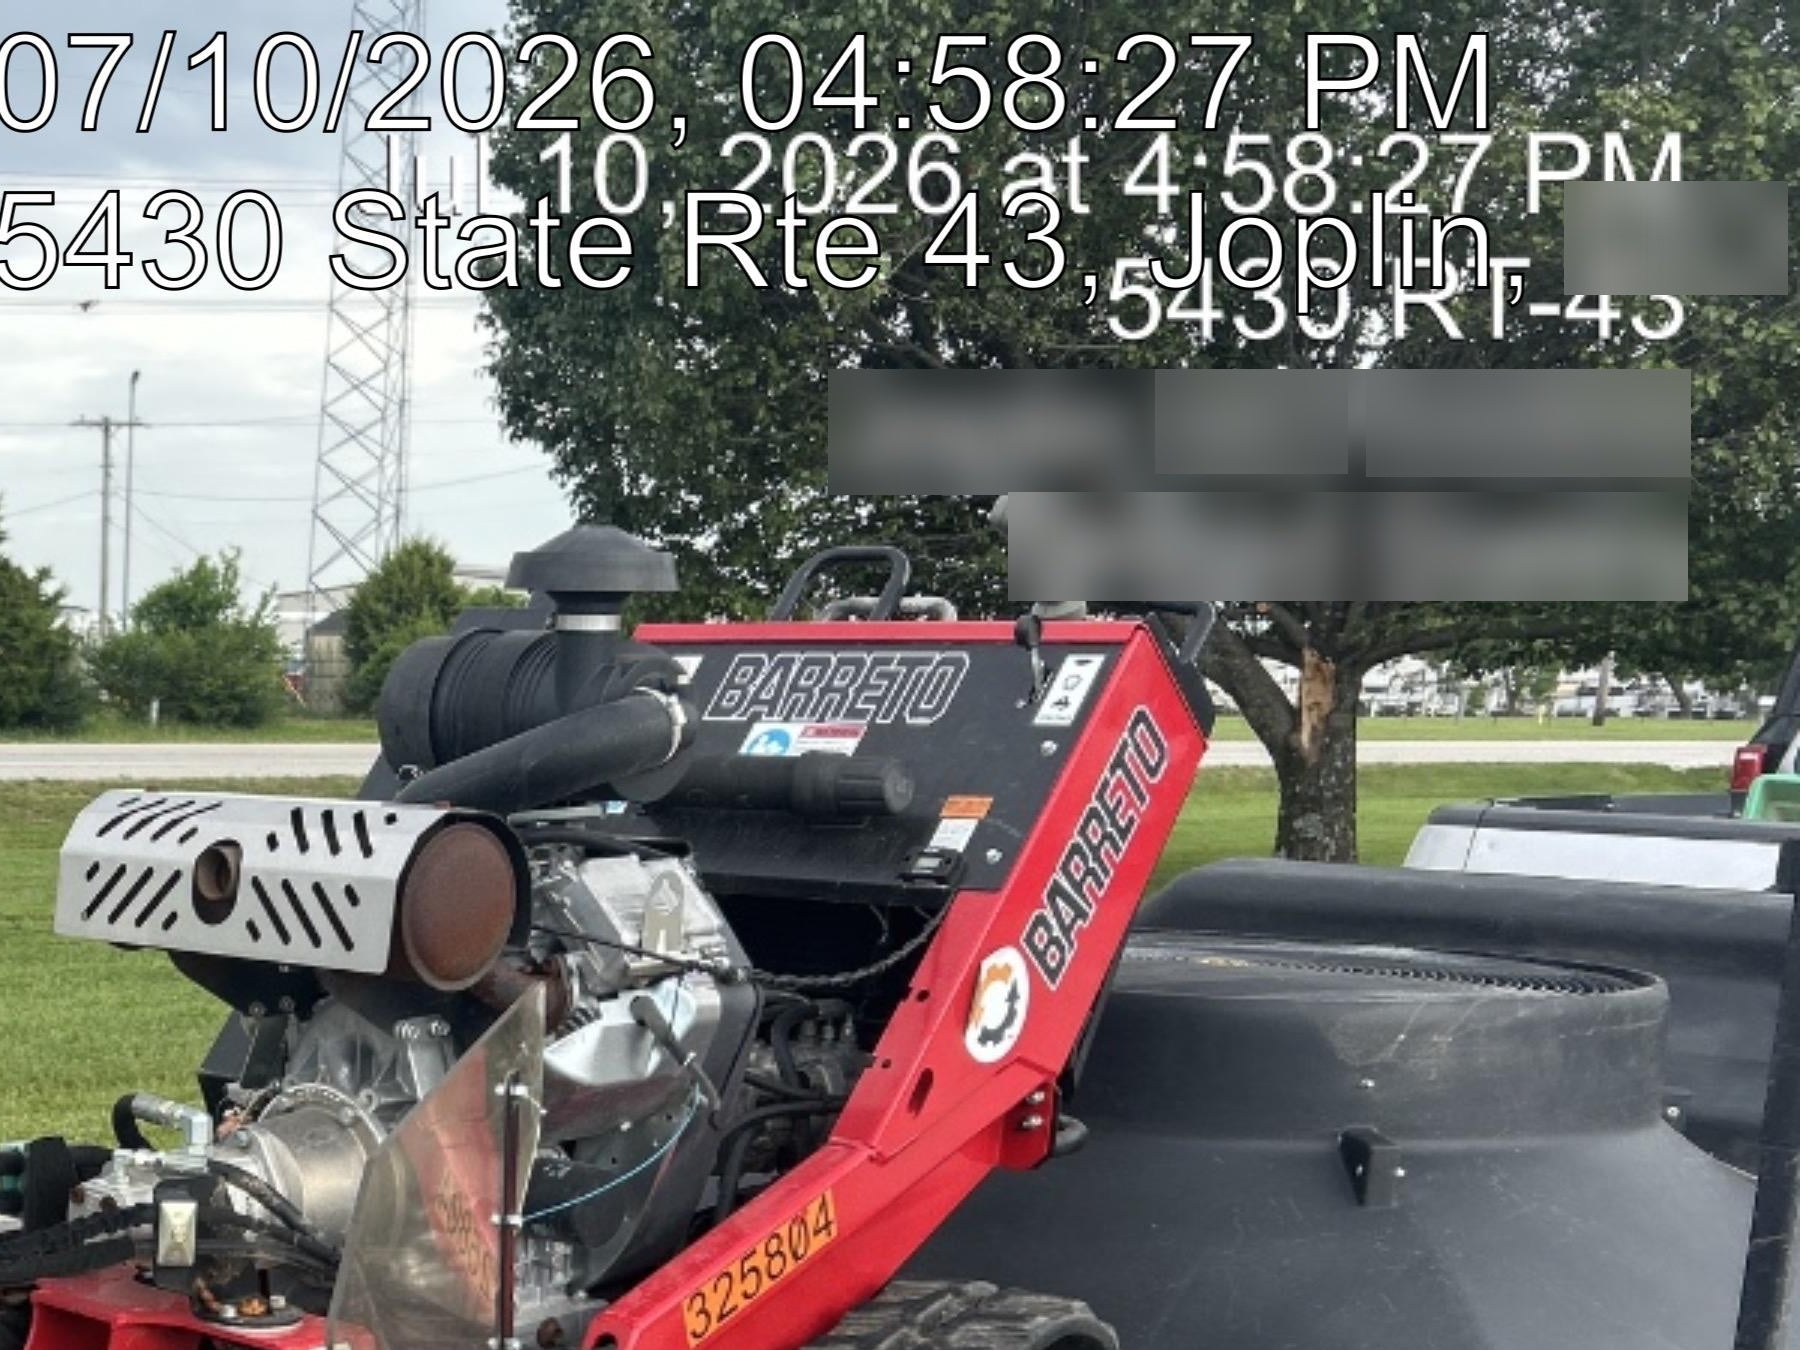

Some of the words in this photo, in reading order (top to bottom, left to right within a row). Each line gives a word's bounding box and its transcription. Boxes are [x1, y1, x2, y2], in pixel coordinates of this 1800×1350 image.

[703, 650, 971, 724] BARRETO
[1019, 704, 1171, 991] BARRETO
[686, 1192, 834, 1339] 325804
